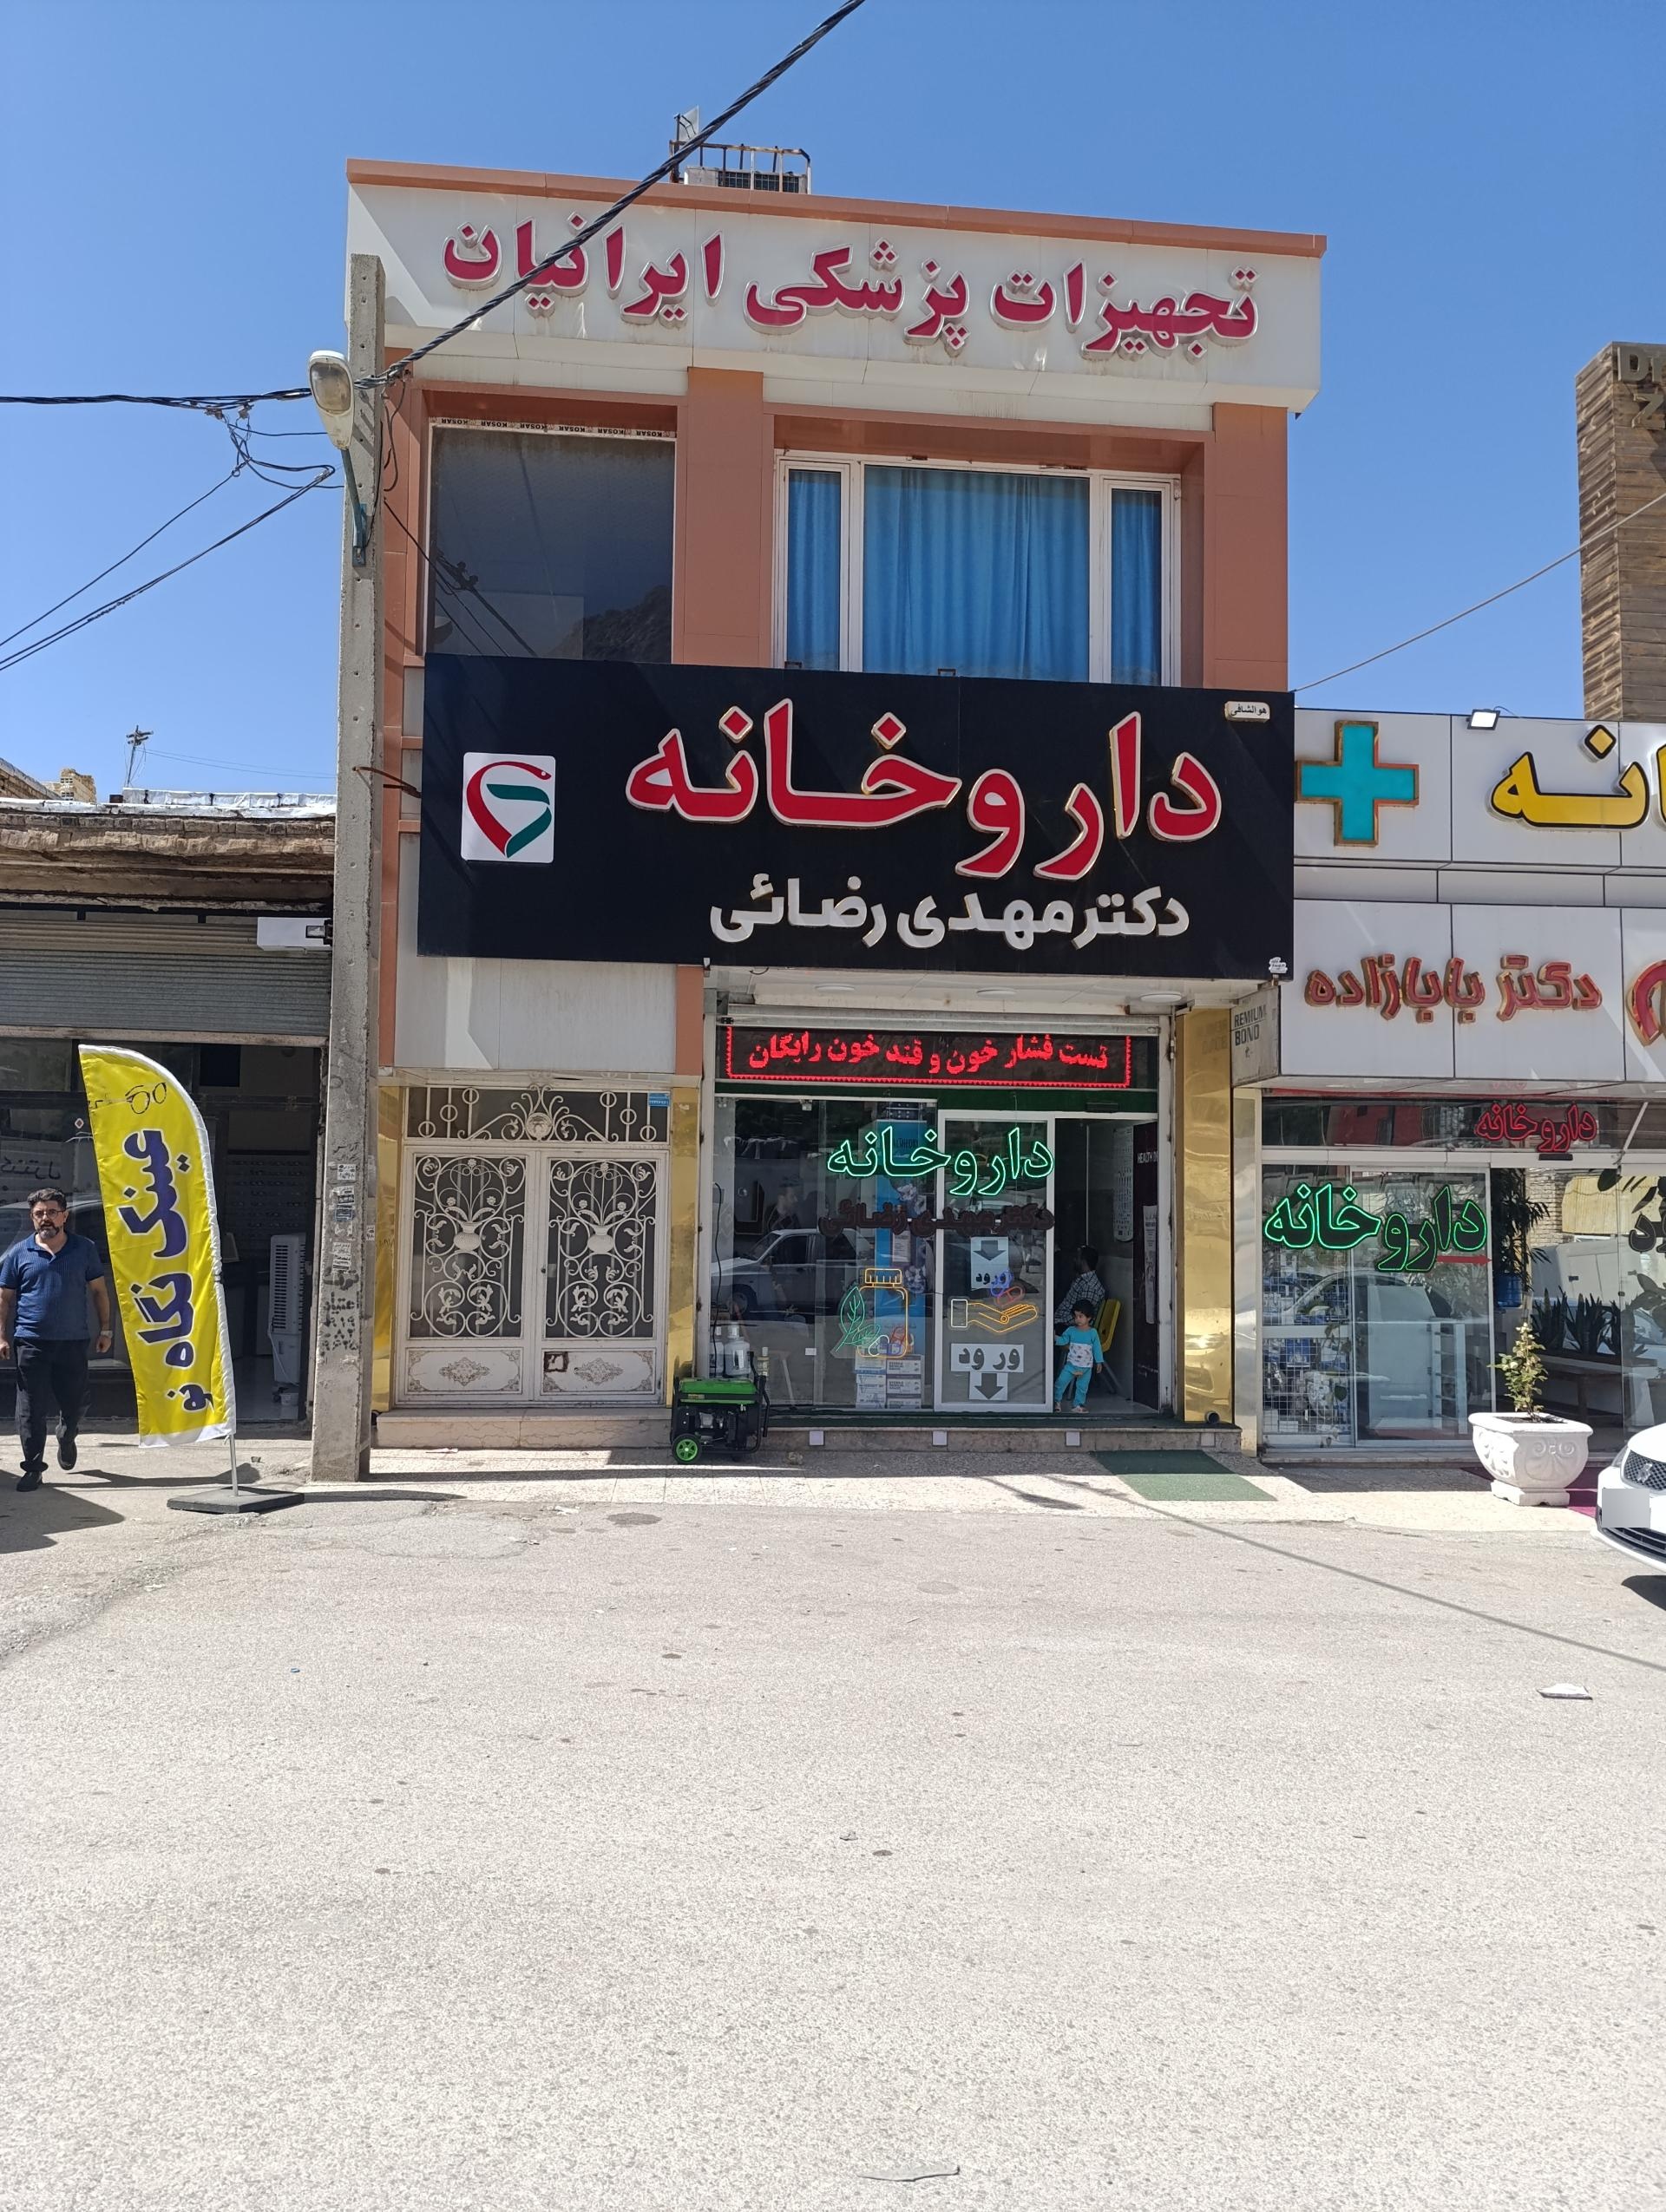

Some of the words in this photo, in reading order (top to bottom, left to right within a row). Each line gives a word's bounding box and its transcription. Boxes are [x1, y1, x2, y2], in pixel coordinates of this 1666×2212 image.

[442, 211, 726, 326] ایرانیان
[744, 238, 970, 354] پزشکی
[990, 259, 1259, 361] تجهیزات
[626, 697, 1222, 881] داروخانه
[710, 873, 887, 948] رضائی
[896, 892, 1074, 950] مهدی
[1072, 886, 1190, 950] دکتر
[1304, 953, 1486, 1024] بابازاده
[1496, 955, 1603, 1022] دکتر
[749, 1031, 823, 1069] رایگان
[827, 1033, 881, 1063] خون
[885, 1038, 924, 1066] قند
[928, 1053, 941, 1074] و
[946, 1039, 998, 1075] خون
[1003, 1033, 1053, 1069] فشار
[1058, 1044, 1108, 1069] تست
[1235, 1024, 1260, 1046] BOND
[1474, 1103, 1597, 1153] داروخانه
[827, 1125, 1055, 1196] داروخانه
[118, 1129, 191, 1258] عینک
[1263, 1181, 1488, 1272] داروخانه
[130, 1273, 195, 1368] نگاه
[958, 1347, 1021, 1371] ورود
